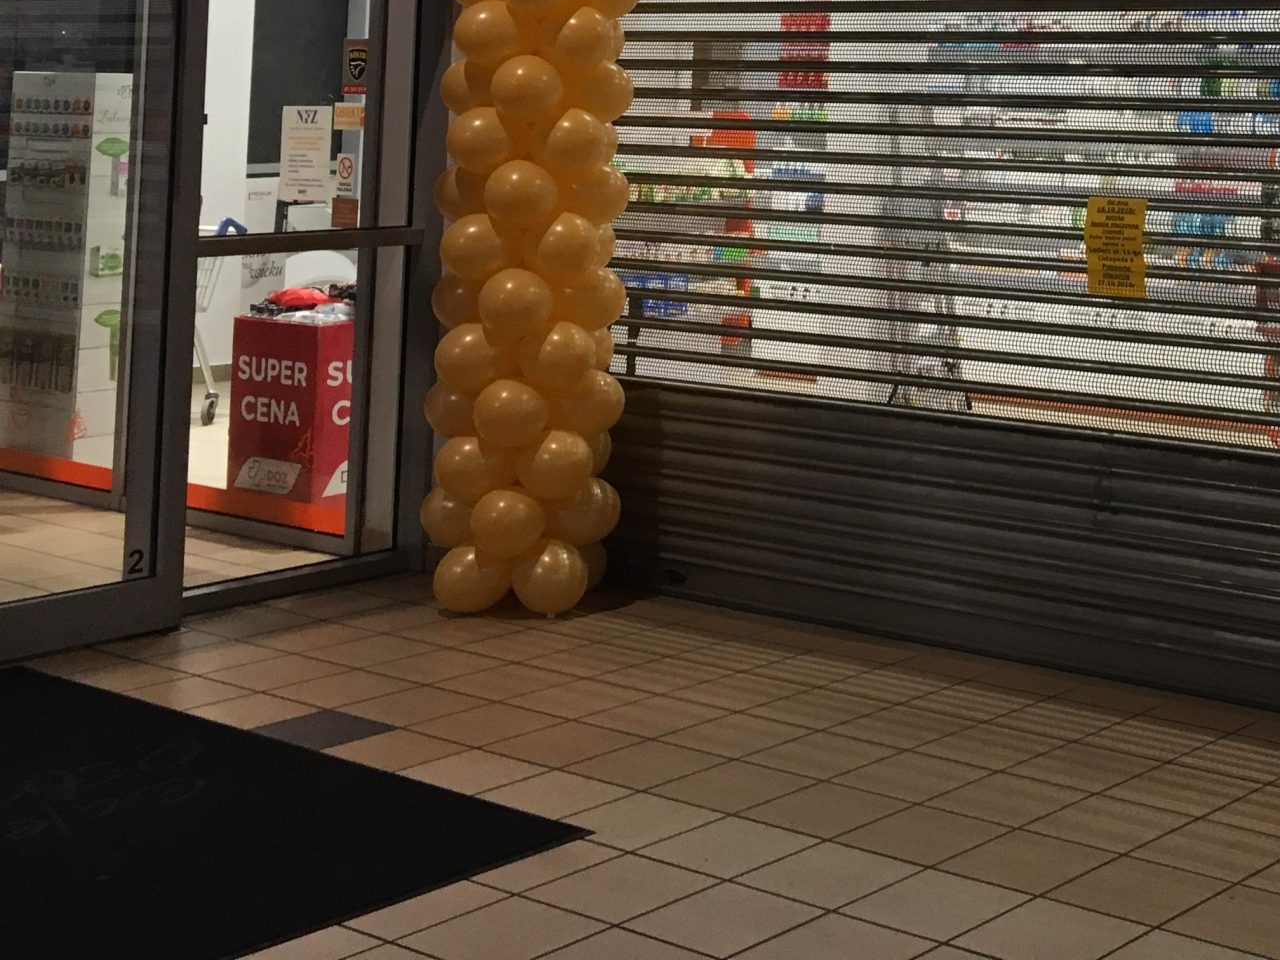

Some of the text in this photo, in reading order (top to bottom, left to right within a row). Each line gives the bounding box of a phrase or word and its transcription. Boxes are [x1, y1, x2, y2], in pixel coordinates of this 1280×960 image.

[297, 110, 318, 124] NFZ
[237, 355, 308, 388] SUPER
[240, 395, 301, 428] CENA
[127, 549, 144, 575] 2
